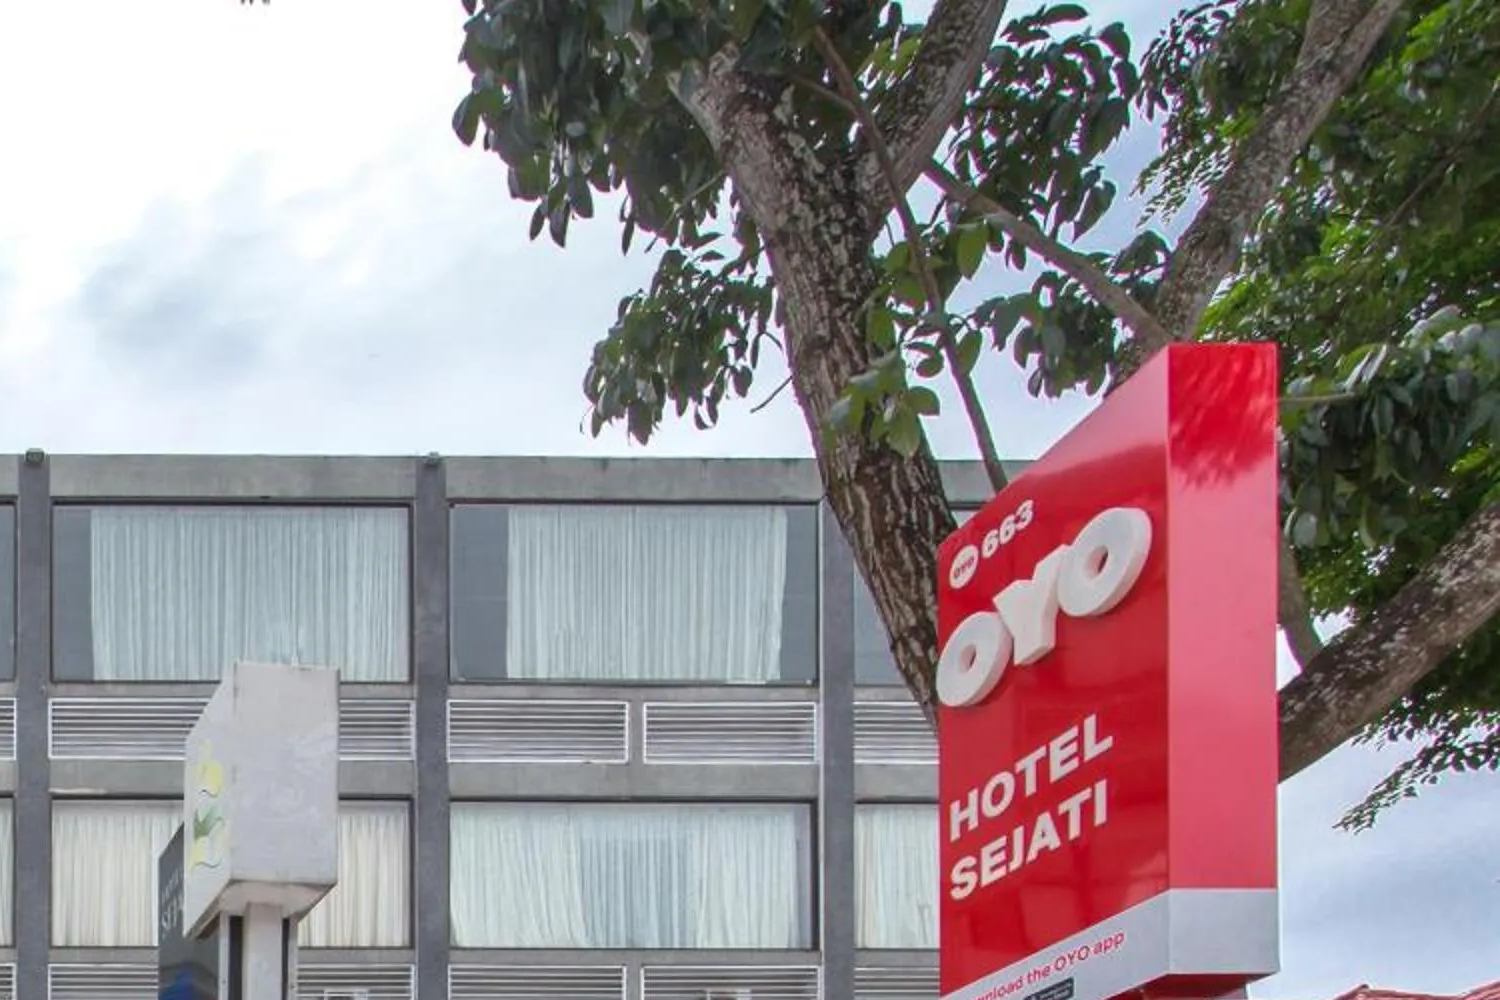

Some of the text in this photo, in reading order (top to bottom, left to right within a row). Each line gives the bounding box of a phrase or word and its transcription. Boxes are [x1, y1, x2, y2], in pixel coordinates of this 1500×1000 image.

[981, 499, 1034, 559] 663
[936, 507, 1153, 707] OYO
[950, 713, 1113, 843] HOTEL
[950, 779, 1108, 900] SEJATI
[1027, 965, 1052, 985] the
[1054, 945, 1090, 971] OYO
[1093, 933, 1125, 955] app
